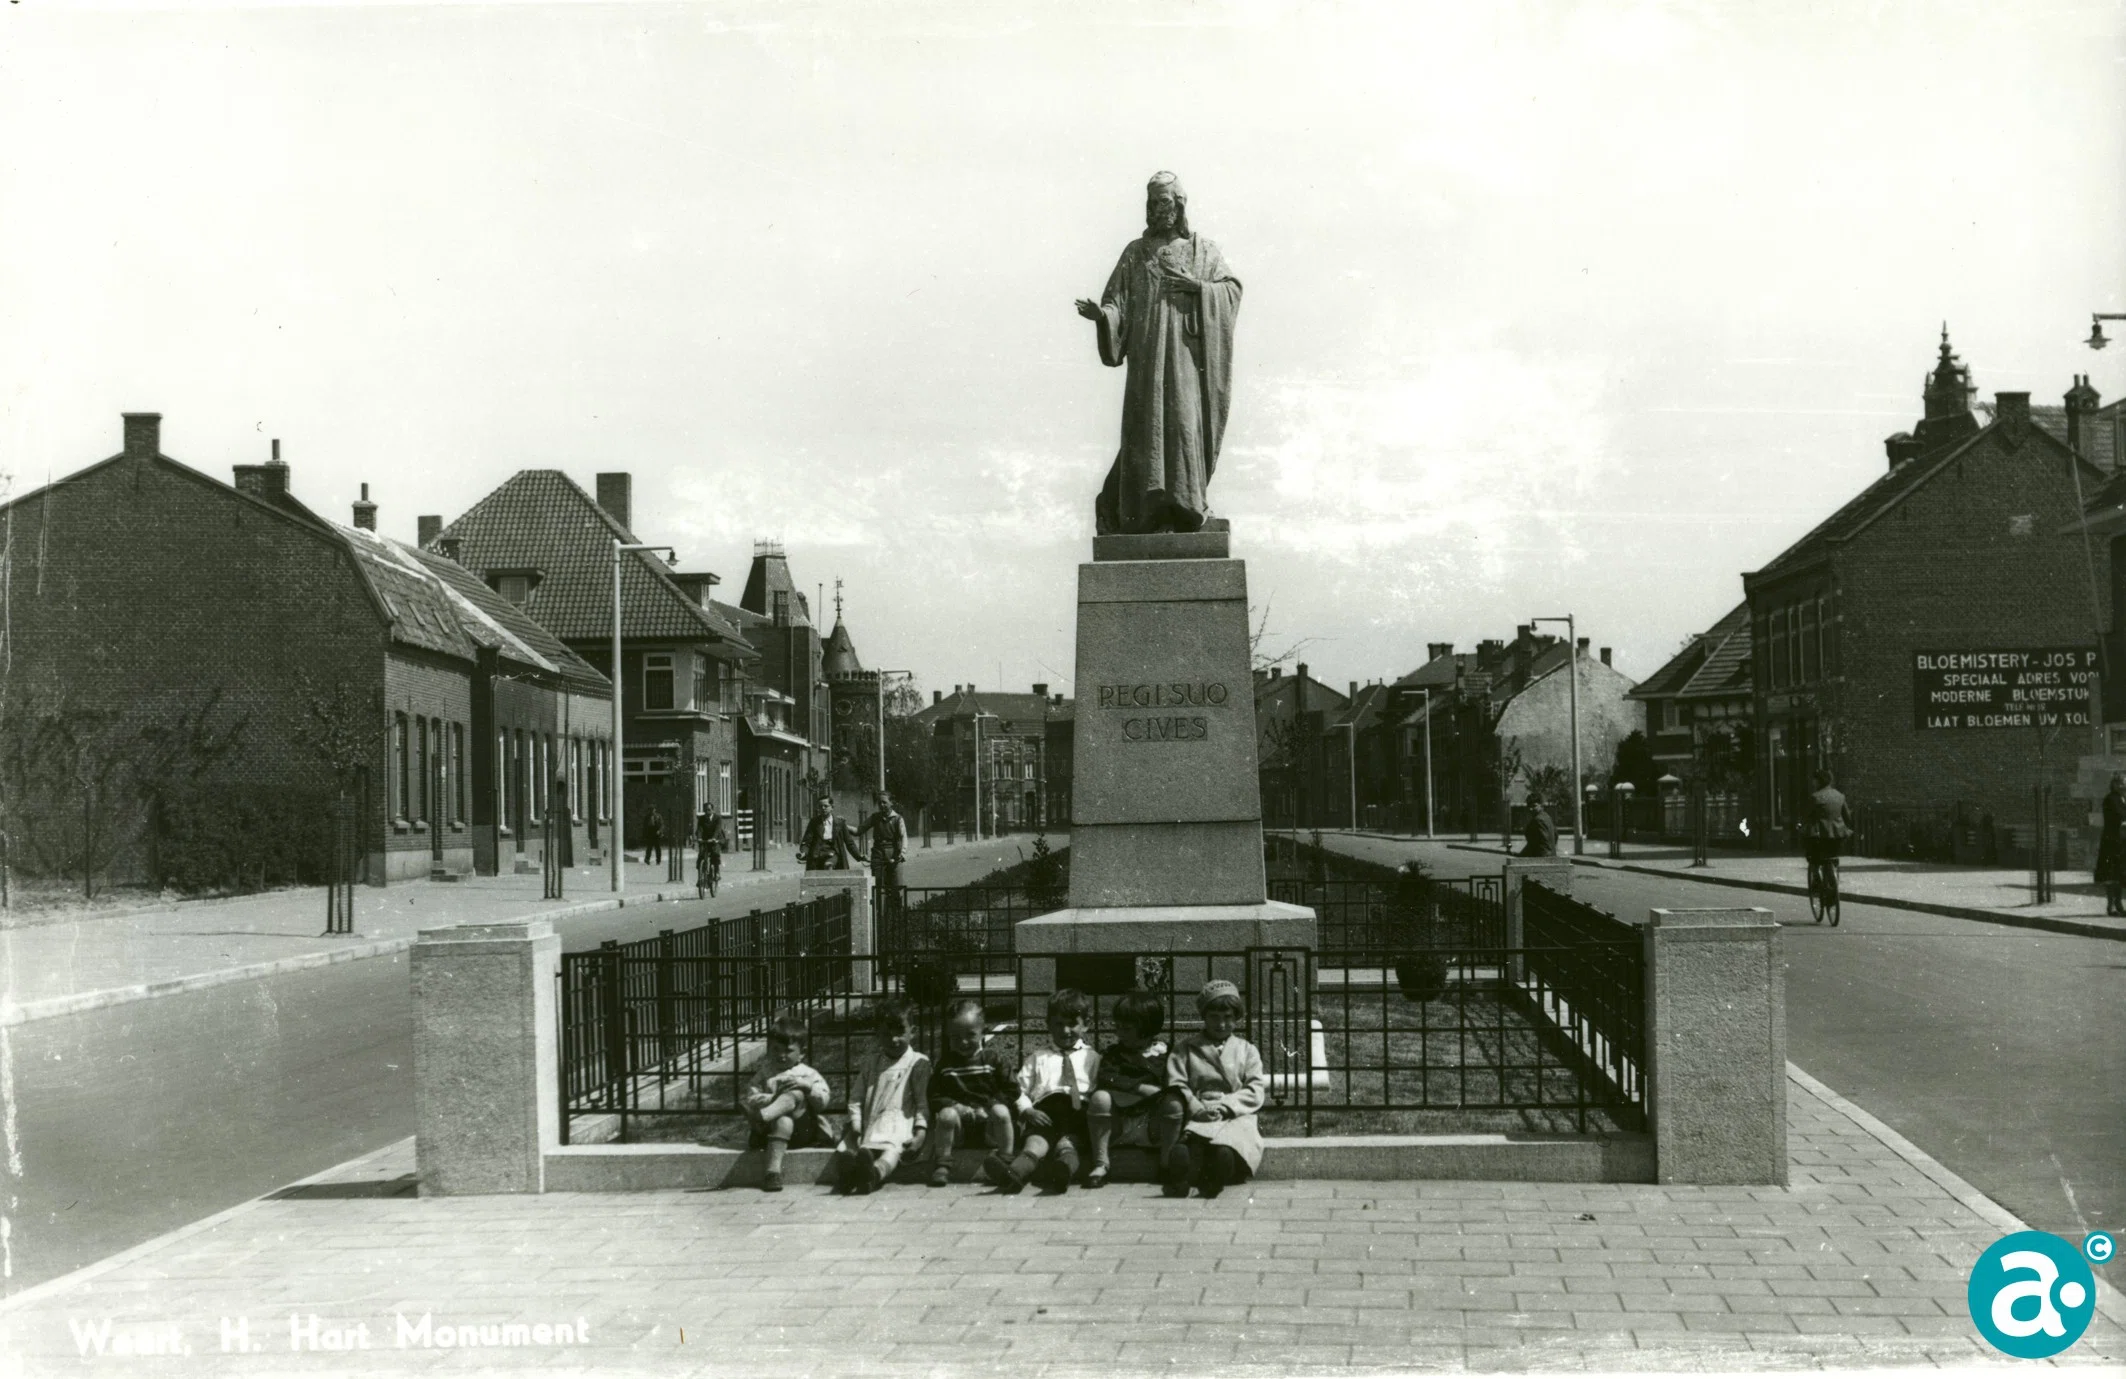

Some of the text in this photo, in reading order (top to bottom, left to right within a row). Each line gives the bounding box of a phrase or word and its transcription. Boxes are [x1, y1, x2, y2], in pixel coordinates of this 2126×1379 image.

[1917, 653, 2029, 669] BLOEMISTERY
[2043, 652, 2076, 667] JOS
[1943, 673, 2007, 687] SPECIAAL
[2017, 671, 2061, 685] ADRES
[1099, 682, 1228, 707] REGI SUO
[1931, 689, 1992, 703] MODERNE
[1927, 715, 1960, 728] LAAT
[1967, 713, 2031, 728] BLOEMEN
[2038, 713, 2058, 727] UW
[1125, 717, 1207, 741] CIVES
